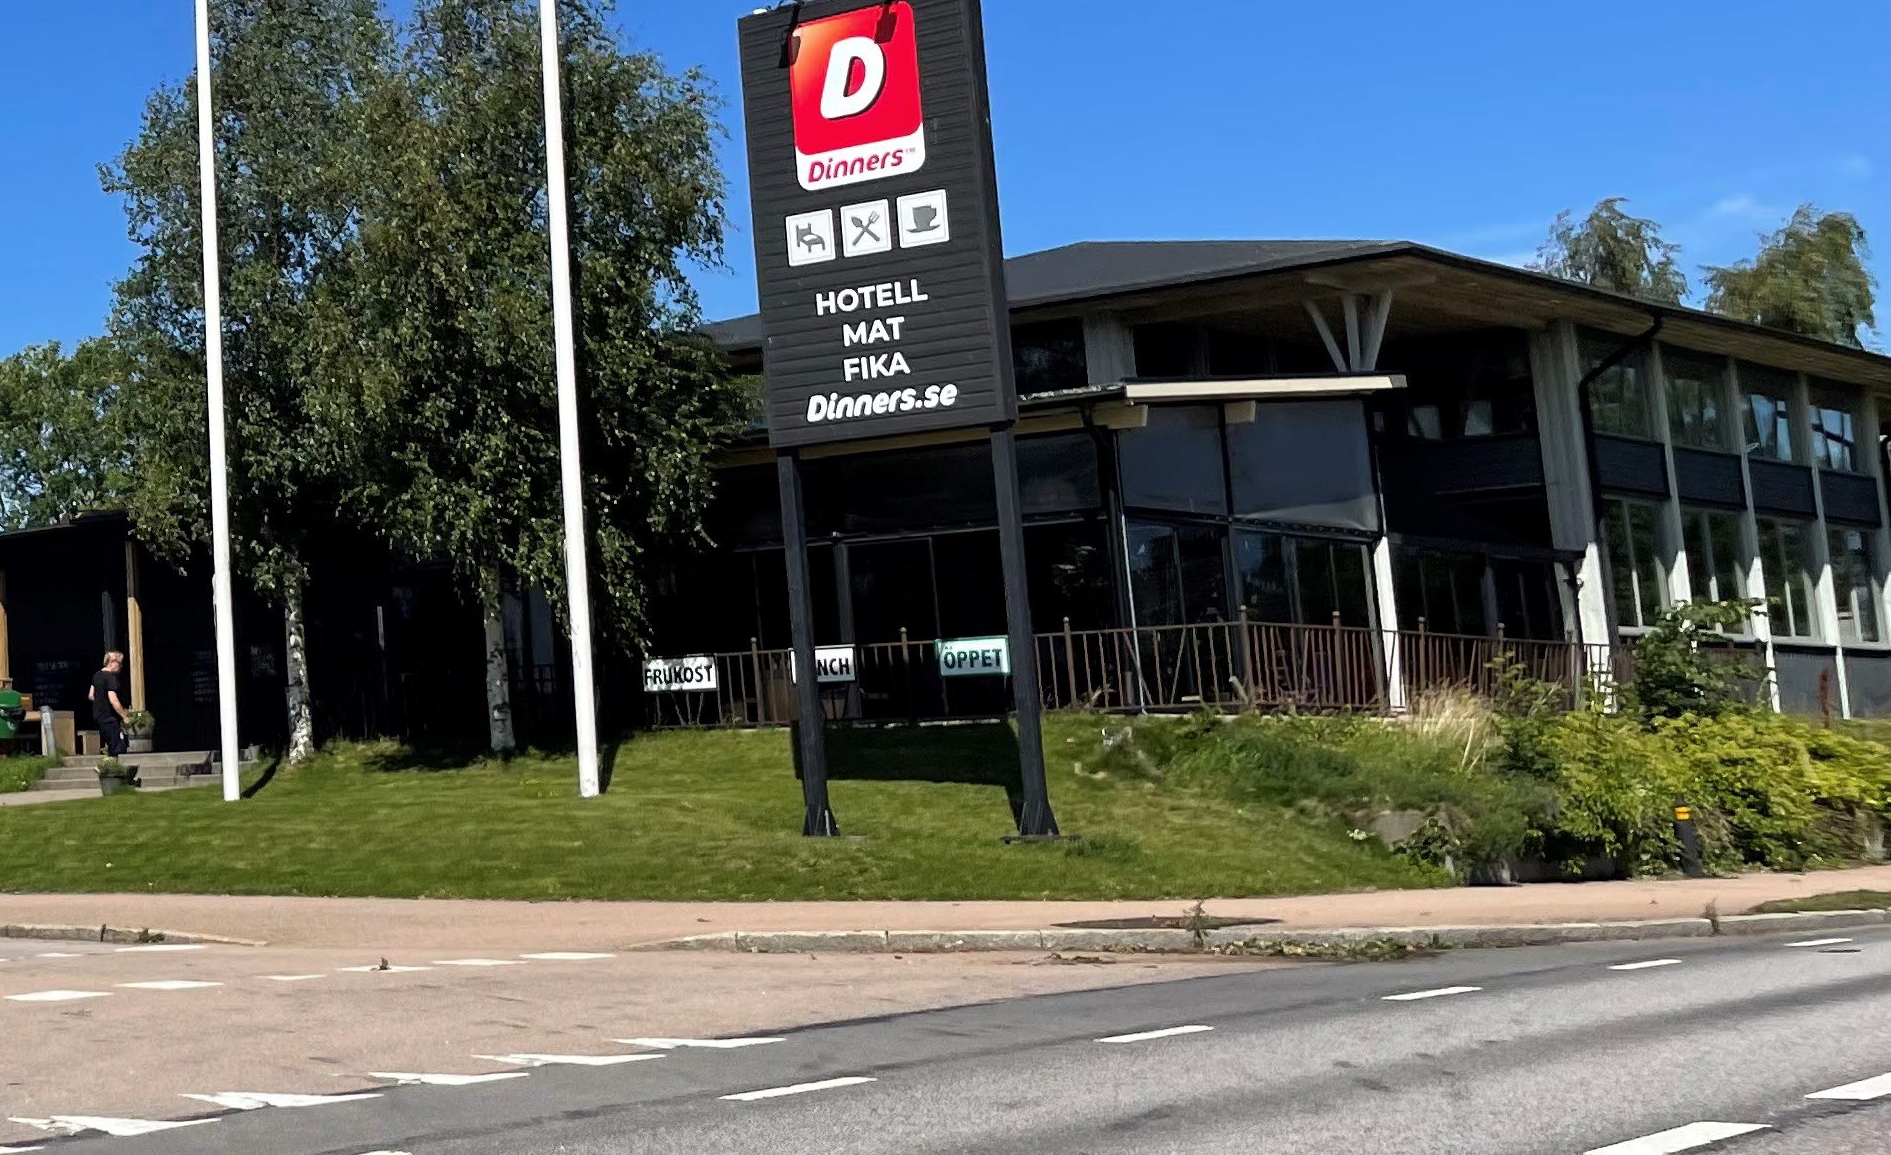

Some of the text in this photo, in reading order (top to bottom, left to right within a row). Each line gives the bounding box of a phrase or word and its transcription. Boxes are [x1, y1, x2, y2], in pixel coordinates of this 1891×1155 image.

[820, 36, 886, 120] D
[808, 149, 904, 183] Dinners
[815, 278, 928, 316] HOTELL
[842, 316, 905, 347] MAT
[843, 351, 910, 382] FIKA
[807, 384, 958, 422] Dinners.se
[817, 658, 850, 676] NCH
[943, 645, 1002, 669] ÖPPET
[644, 665, 713, 685] FRUKOST
